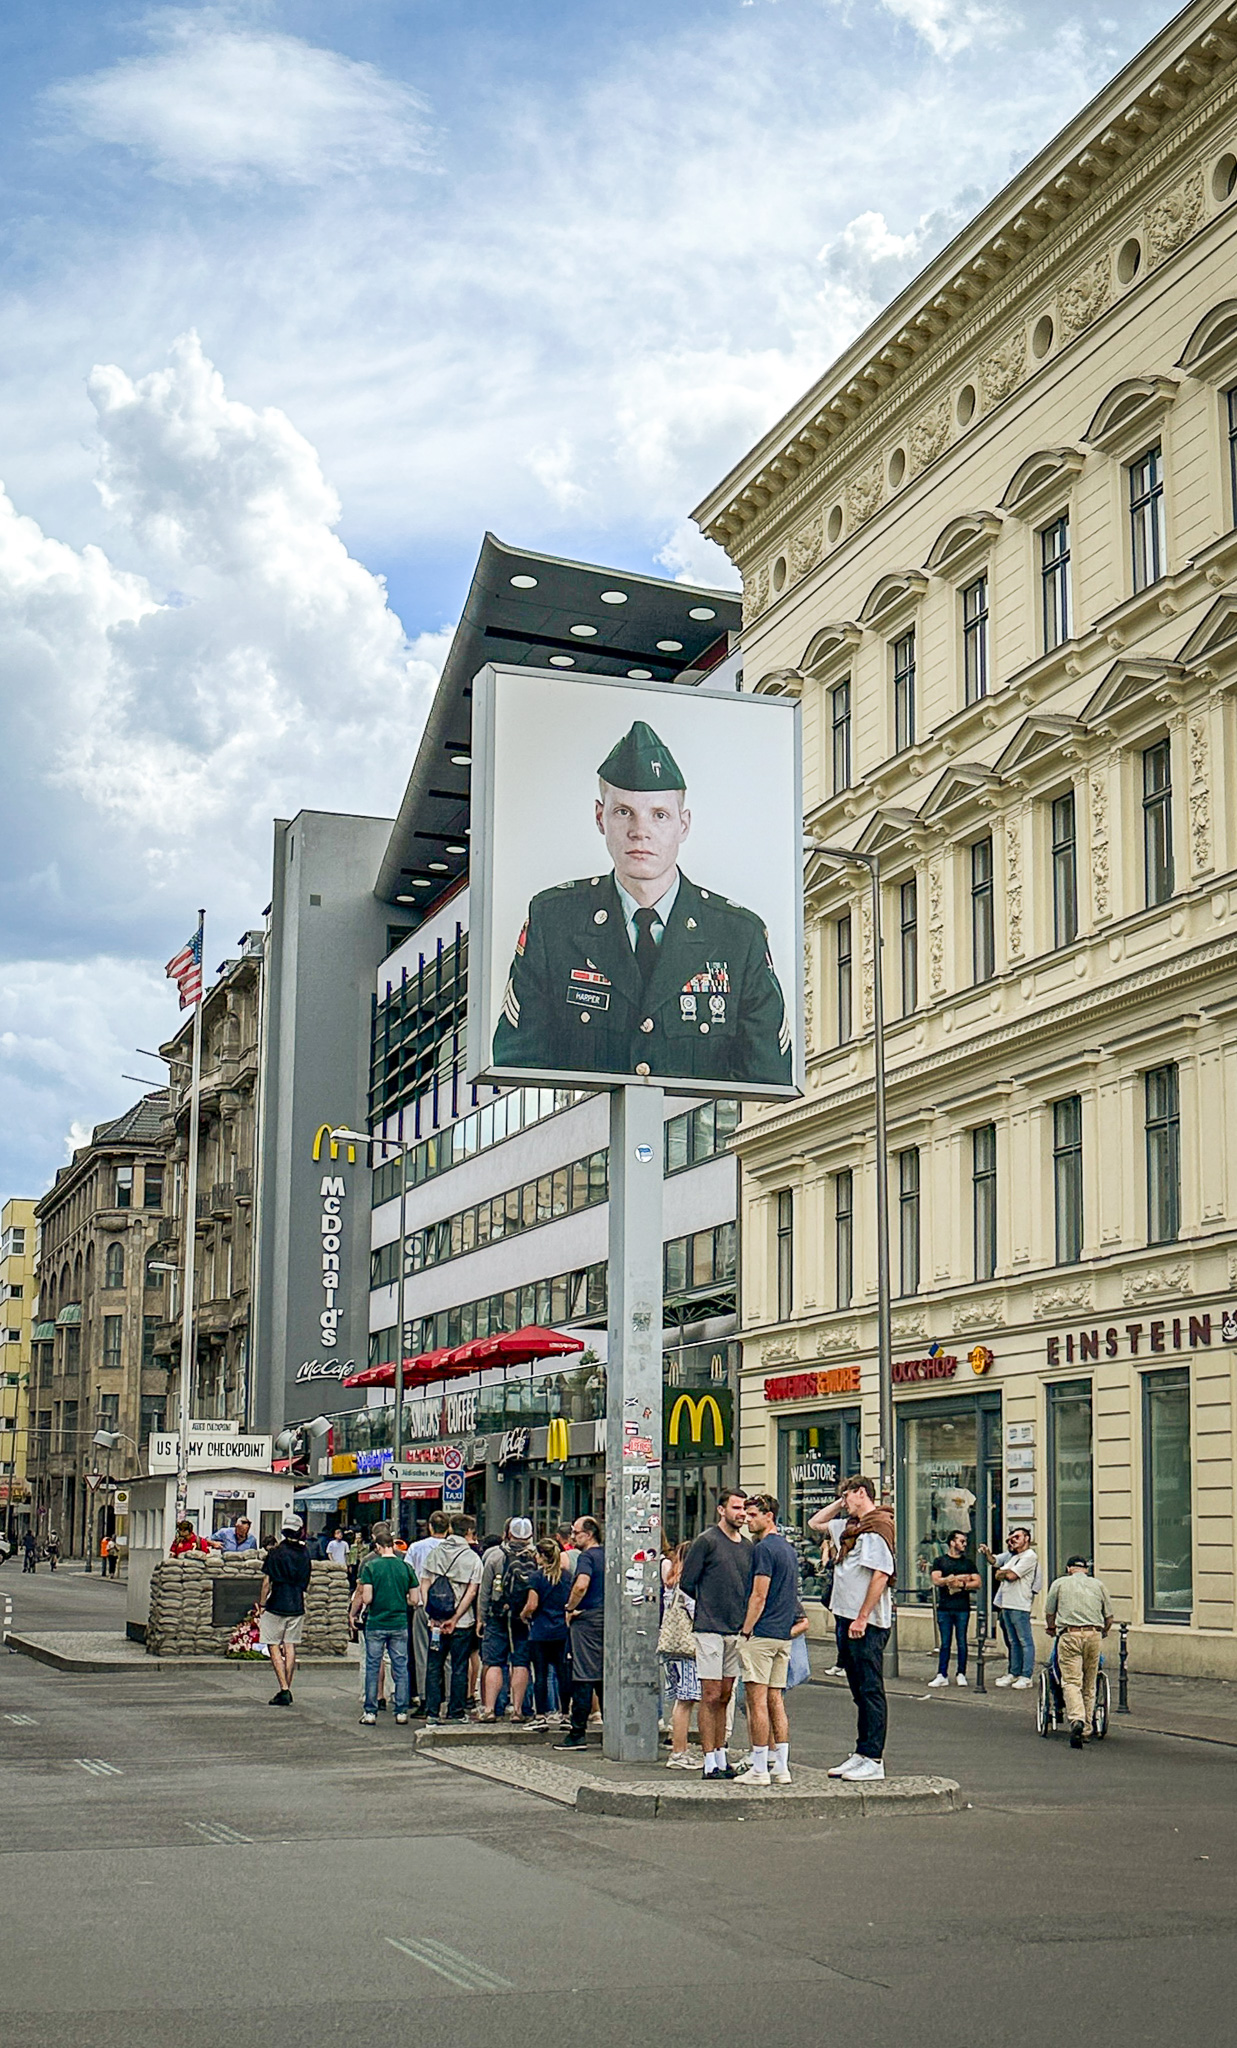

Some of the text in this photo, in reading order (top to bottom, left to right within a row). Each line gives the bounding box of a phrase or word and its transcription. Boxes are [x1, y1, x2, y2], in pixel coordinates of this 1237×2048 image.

[575, 992, 600, 1004] HARPER
[320, 1176, 346, 1347] McDonald's
[1047, 1313, 1211, 1366] EINSTEIN
[892, 1361, 921, 1382] OCK
[919, 1355, 957, 1380] SHOP
[447, 1391, 477, 1434] COFFEE
[157, 1441, 265, 1457] US MY CHECKPOINT
[790, 1463, 836, 1484] WALLSTORE
[445, 1491, 463, 1500] TAXI
